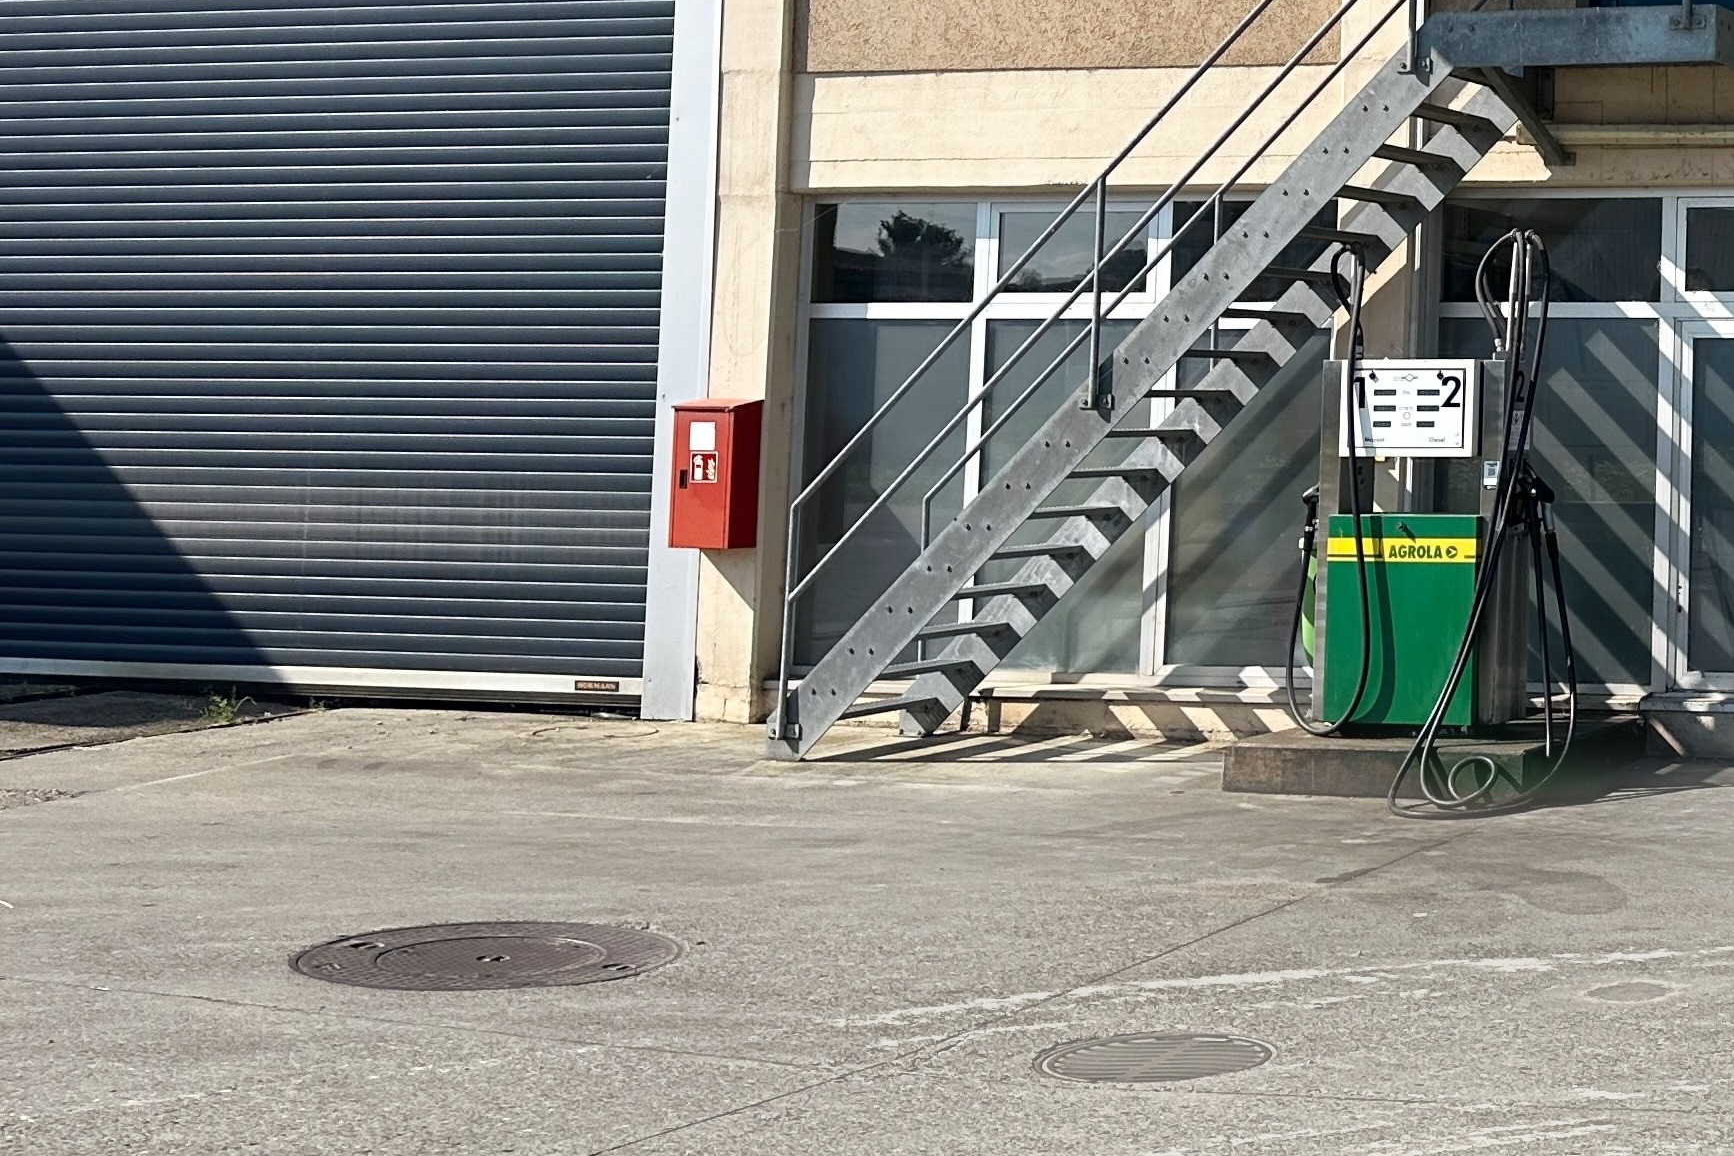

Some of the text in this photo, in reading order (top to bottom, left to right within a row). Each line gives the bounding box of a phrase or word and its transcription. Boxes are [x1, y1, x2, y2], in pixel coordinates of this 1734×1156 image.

[1353, 376, 1365, 409] 1
[1441, 376, 1462, 408] 2
[1388, 544, 1443, 559] AGROLA
